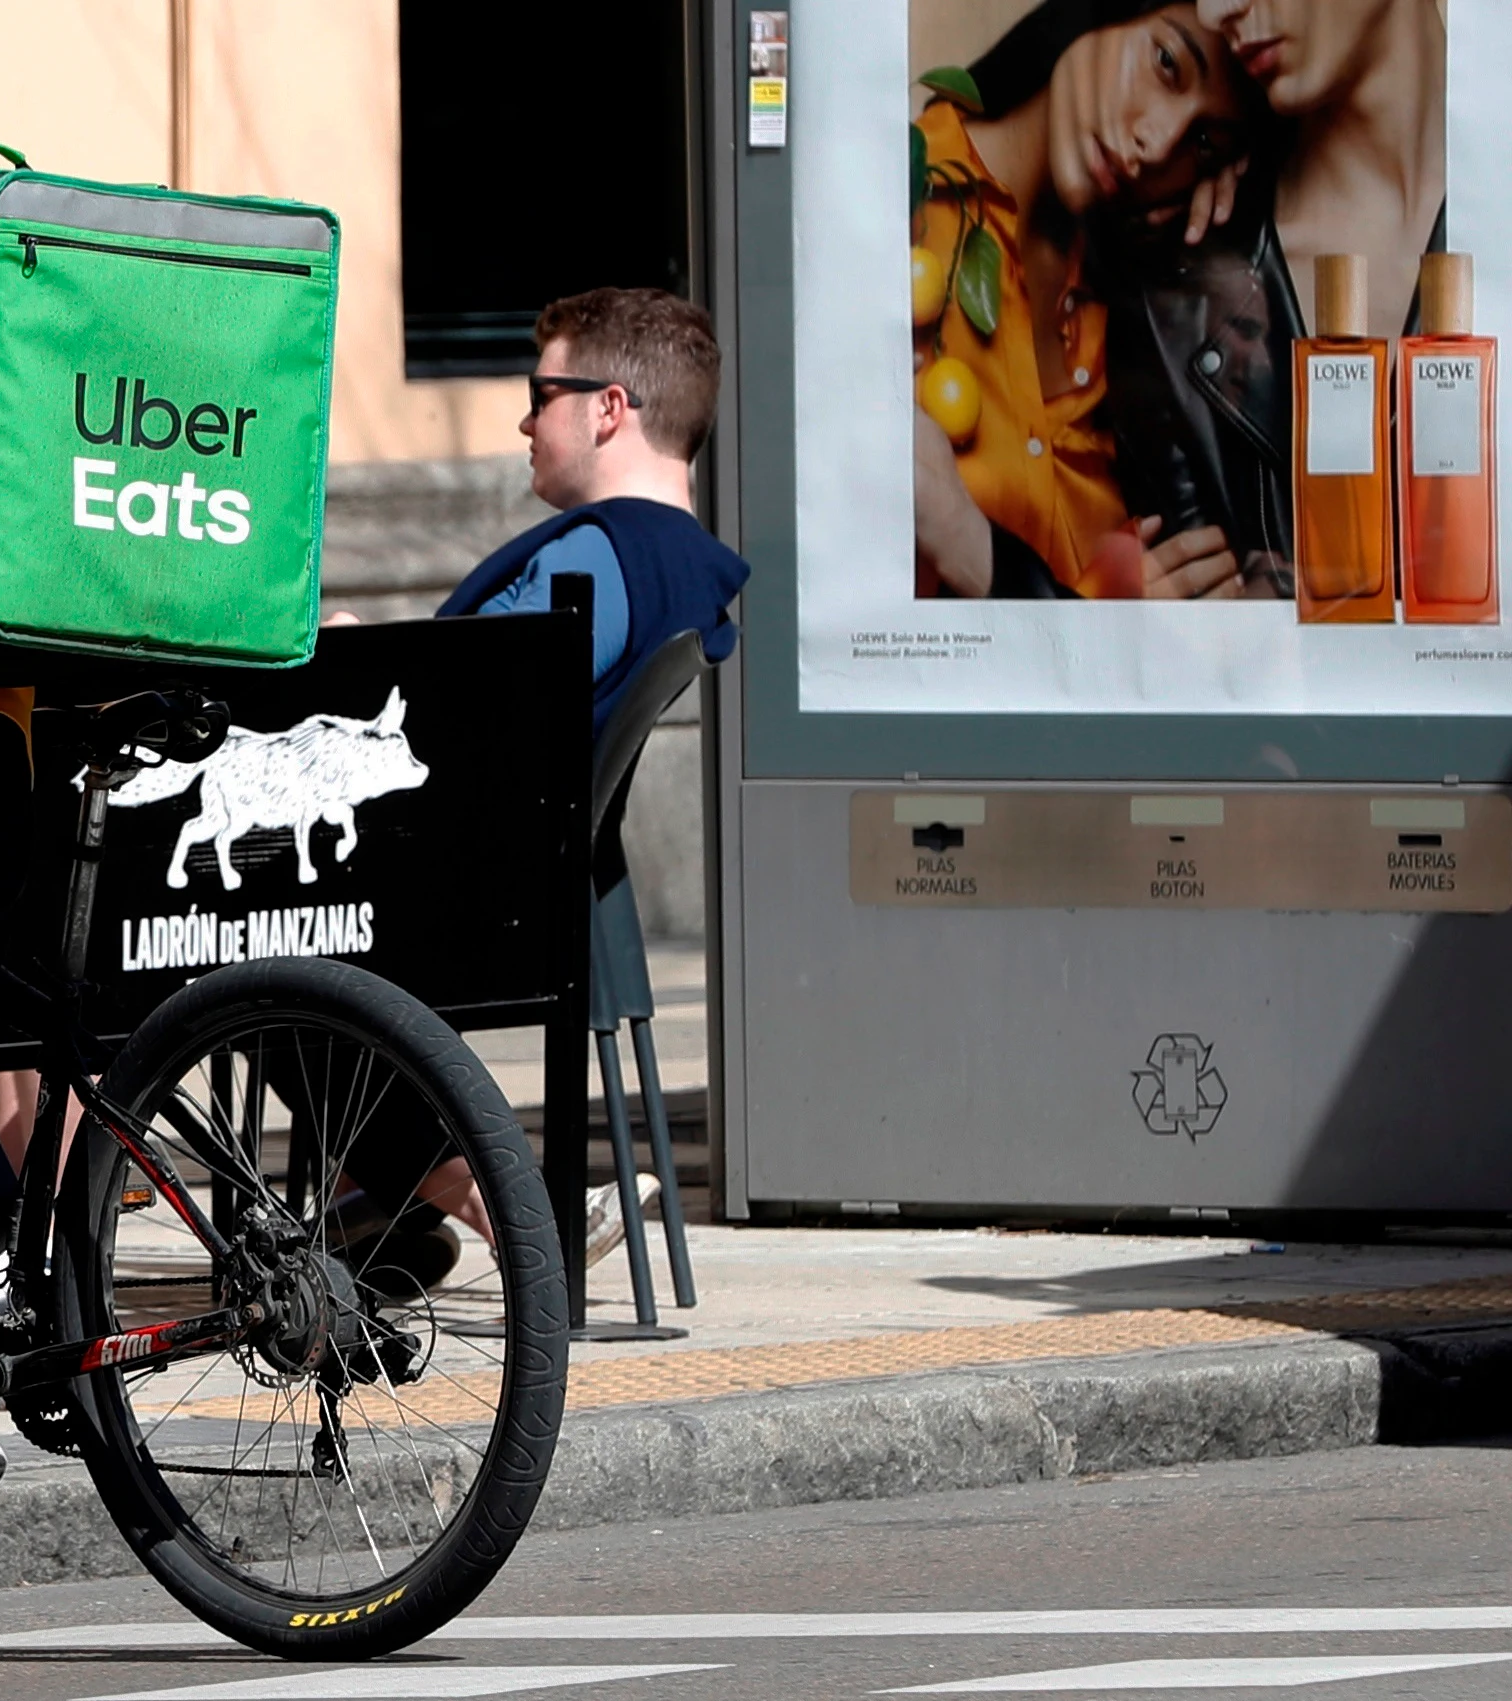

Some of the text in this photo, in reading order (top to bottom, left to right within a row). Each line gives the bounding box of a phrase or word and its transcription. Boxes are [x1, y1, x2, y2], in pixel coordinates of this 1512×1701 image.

[1314, 363, 1368, 380] LOEWE
[1418, 362, 1474, 380] LOEWE
[75, 372, 257, 458] Uber
[73, 456, 250, 544] Eats
[851, 632, 887, 643] LOEWE
[891, 632, 914, 643] Solo
[917, 632, 940, 643] Man
[953, 632, 992, 643] Woman
[853, 647, 901, 659] Botanical
[954, 647, 978, 657] 2021
[917, 857, 956, 874] PILAS
[1157, 860, 1196, 877] PILAS
[1388, 852, 1456, 869] BATERIAS
[896, 878, 977, 895] NORMALES
[1151, 881, 1204, 898] BOTON
[1389, 873, 1455, 891] MOVILES
[123, 902, 373, 971] LADRÓN DE MANZANAS
[289, 1583, 409, 1627] MAXXIS
